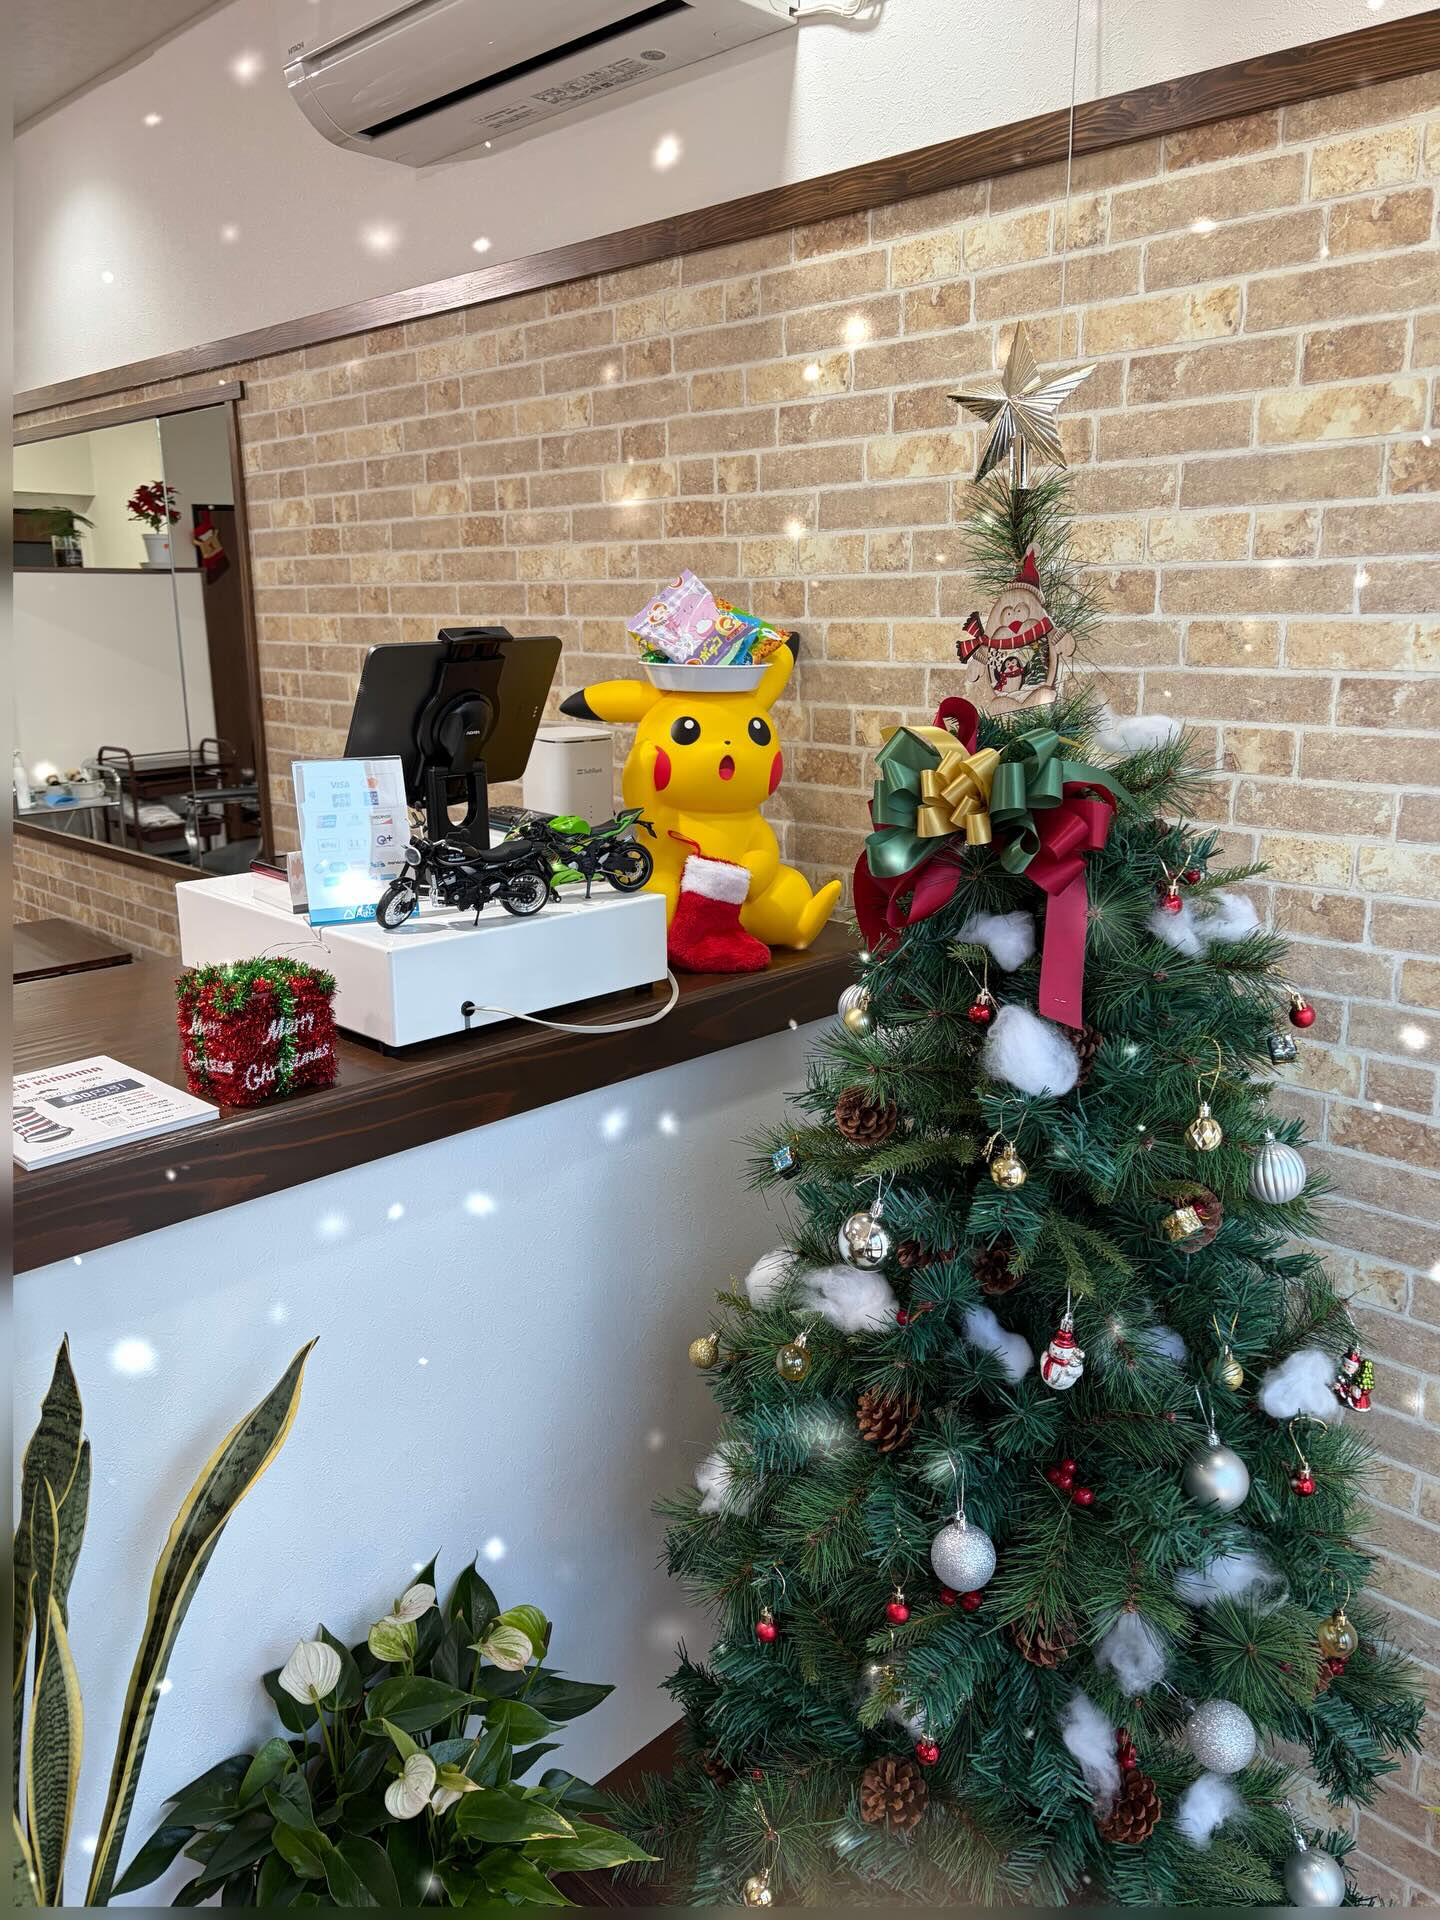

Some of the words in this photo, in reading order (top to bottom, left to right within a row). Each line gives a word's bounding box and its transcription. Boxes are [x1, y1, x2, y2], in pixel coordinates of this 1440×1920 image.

[330, 781, 350, 789] VISA
[261, 1012, 315, 1045] Merry
[32, 1066, 104, 1086] KIMAMA
